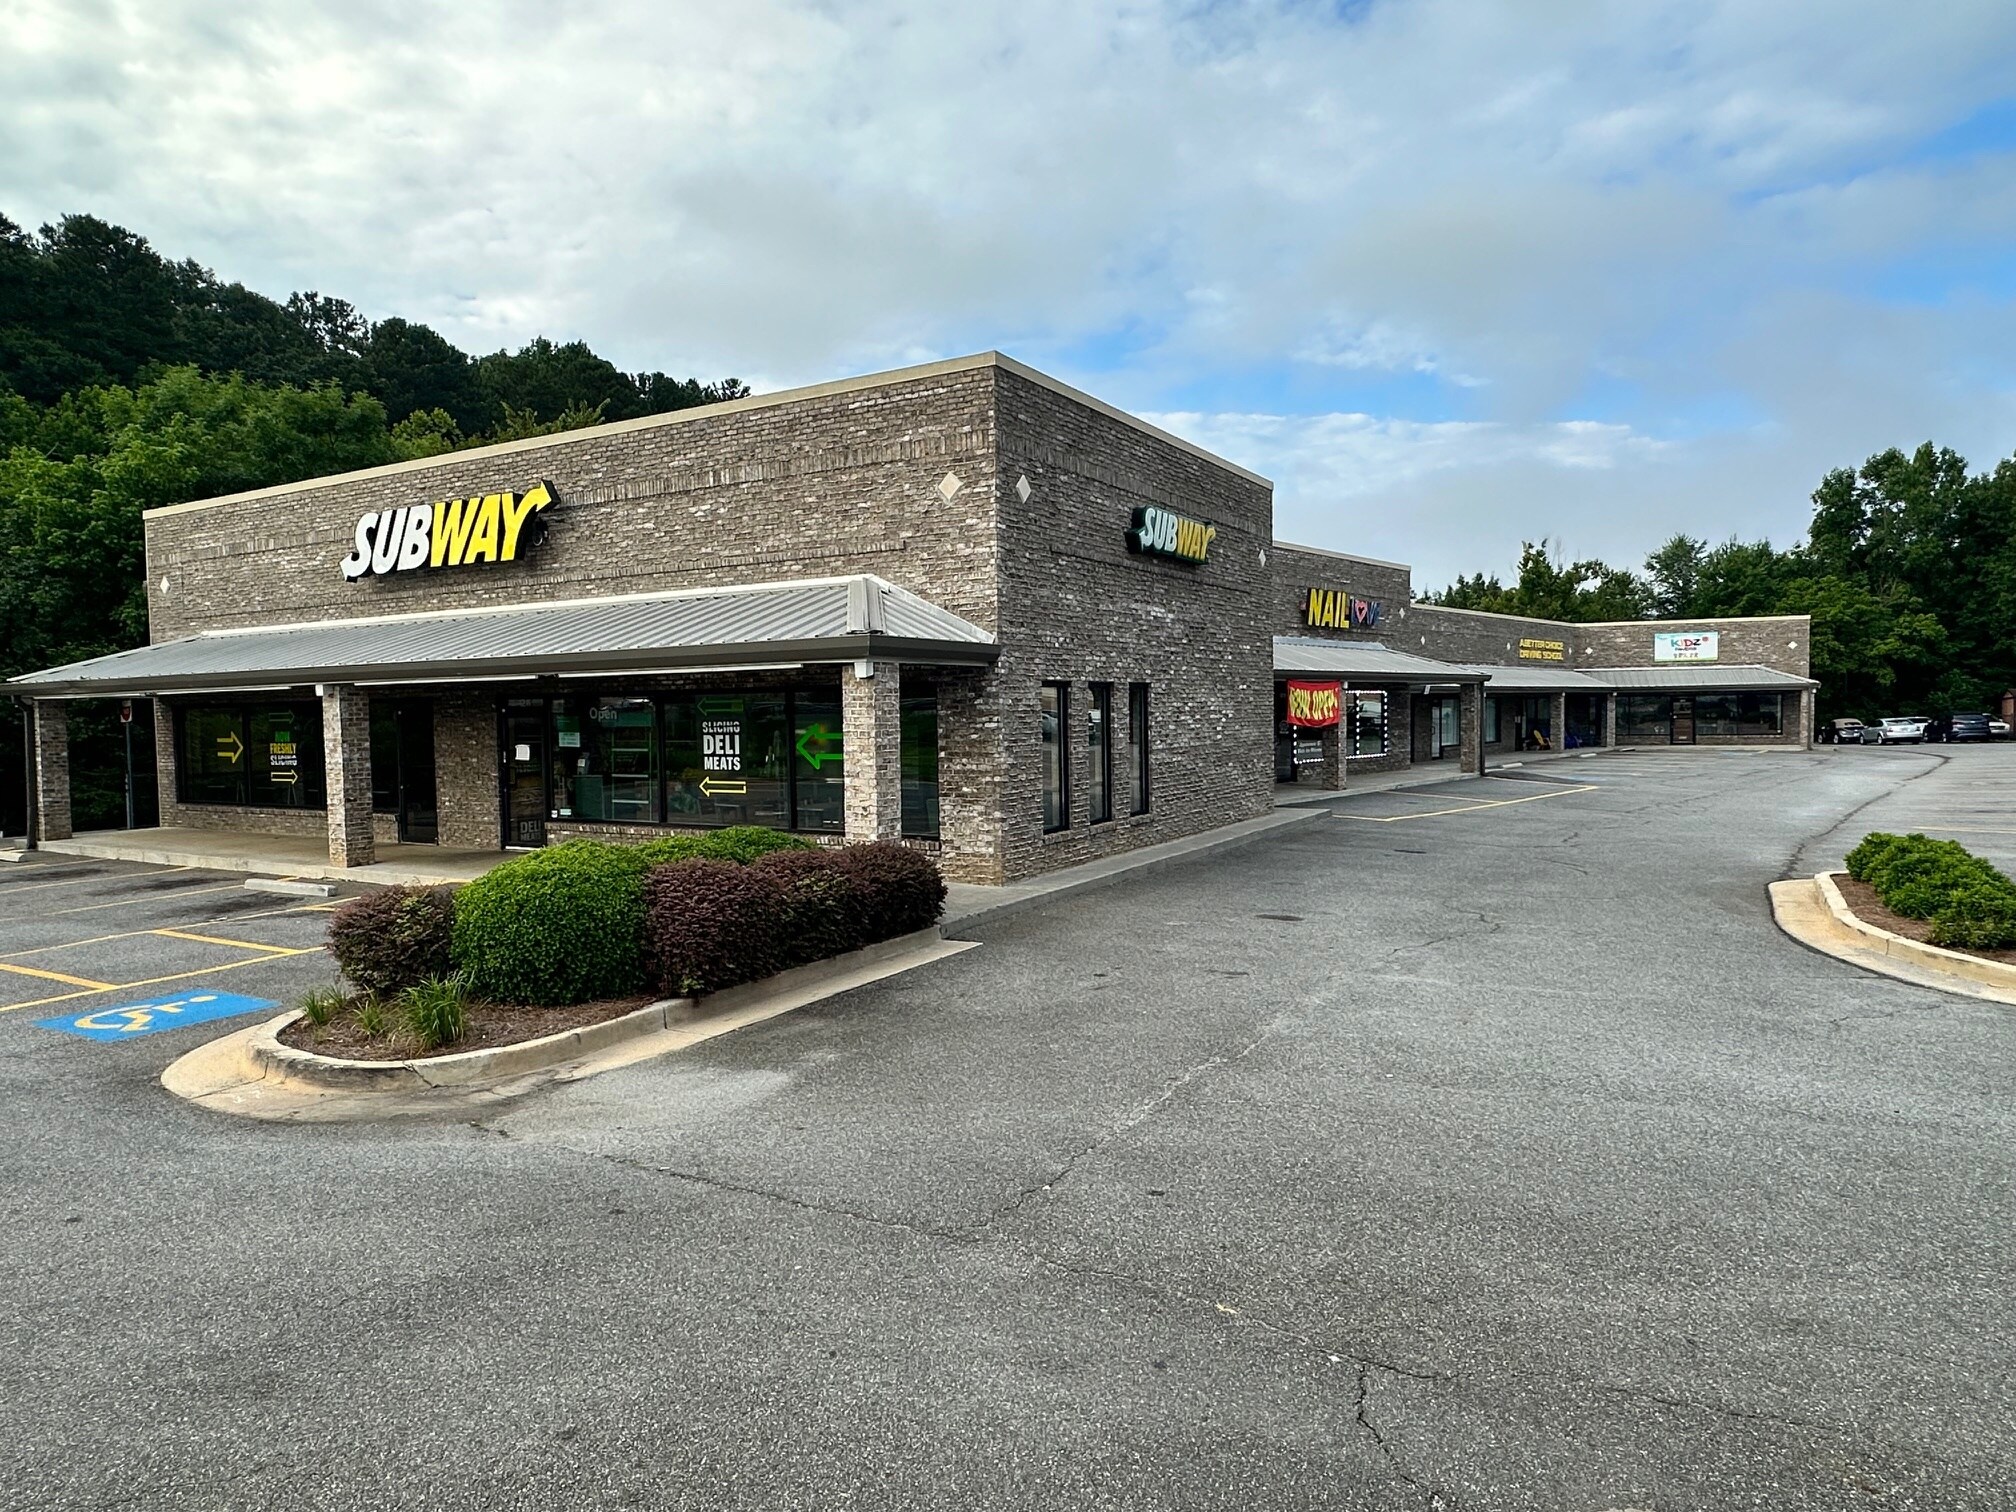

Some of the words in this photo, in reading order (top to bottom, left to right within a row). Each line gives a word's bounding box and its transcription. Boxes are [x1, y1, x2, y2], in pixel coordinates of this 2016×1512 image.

[339, 480, 552, 581] SUBWAY
[1139, 507, 1216, 561] SUBWAY
[1307, 588, 1350, 629] NAIL
[1670, 638, 1702, 648] KIDZ
[1542, 651, 1564, 660] SCHOOL
[589, 707, 618, 722] Open
[702, 721, 741, 733] SLICING
[270, 743, 296, 754] FRESHLY
[703, 734, 740, 755] DELI
[704, 756, 741, 771] MEATS
[520, 820, 541, 834] DELI
